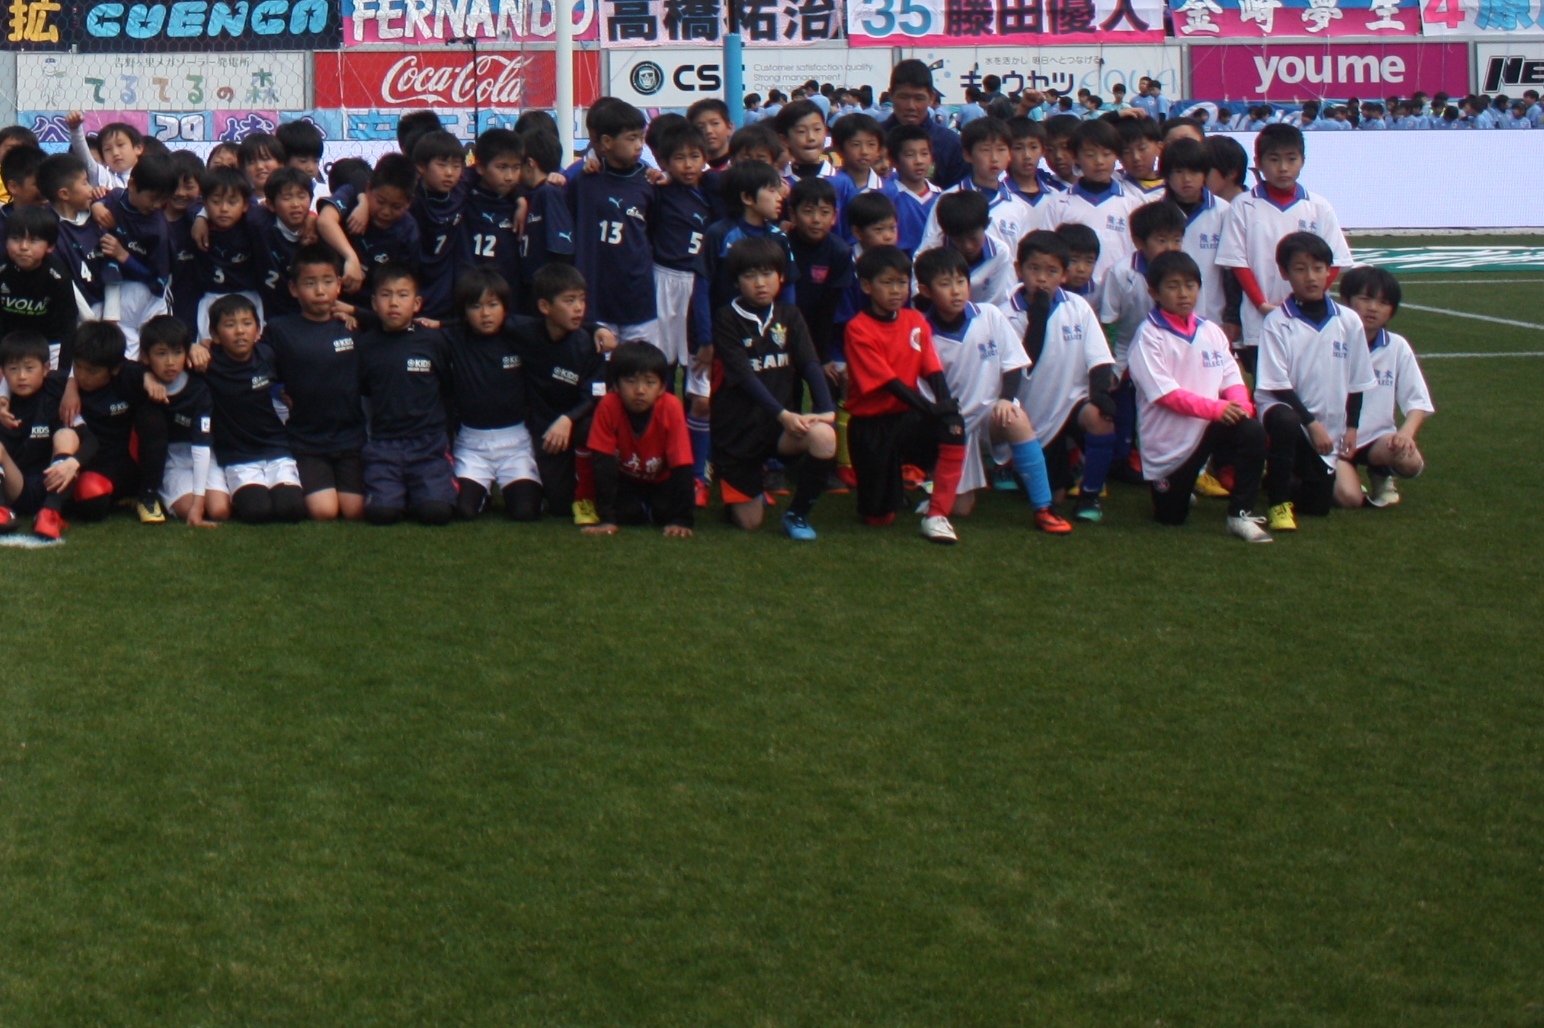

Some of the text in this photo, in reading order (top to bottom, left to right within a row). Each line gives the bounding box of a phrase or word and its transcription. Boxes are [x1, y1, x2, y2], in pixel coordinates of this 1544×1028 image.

[380, 54, 534, 104] Coca-Cola
[673, 64, 747, 92] CS
[753, 63, 873, 74] Customer satisfaction quality
[753, 73, 841, 83] Strong management
[85, 68, 280, 105] てるてるの森
[960, 70, 1074, 96] キウセツ
[599, 220, 623, 245] 13
[688, 231, 703, 255] 5
[473, 234, 497, 257] 12
[31, 425, 50, 436] KIDS
